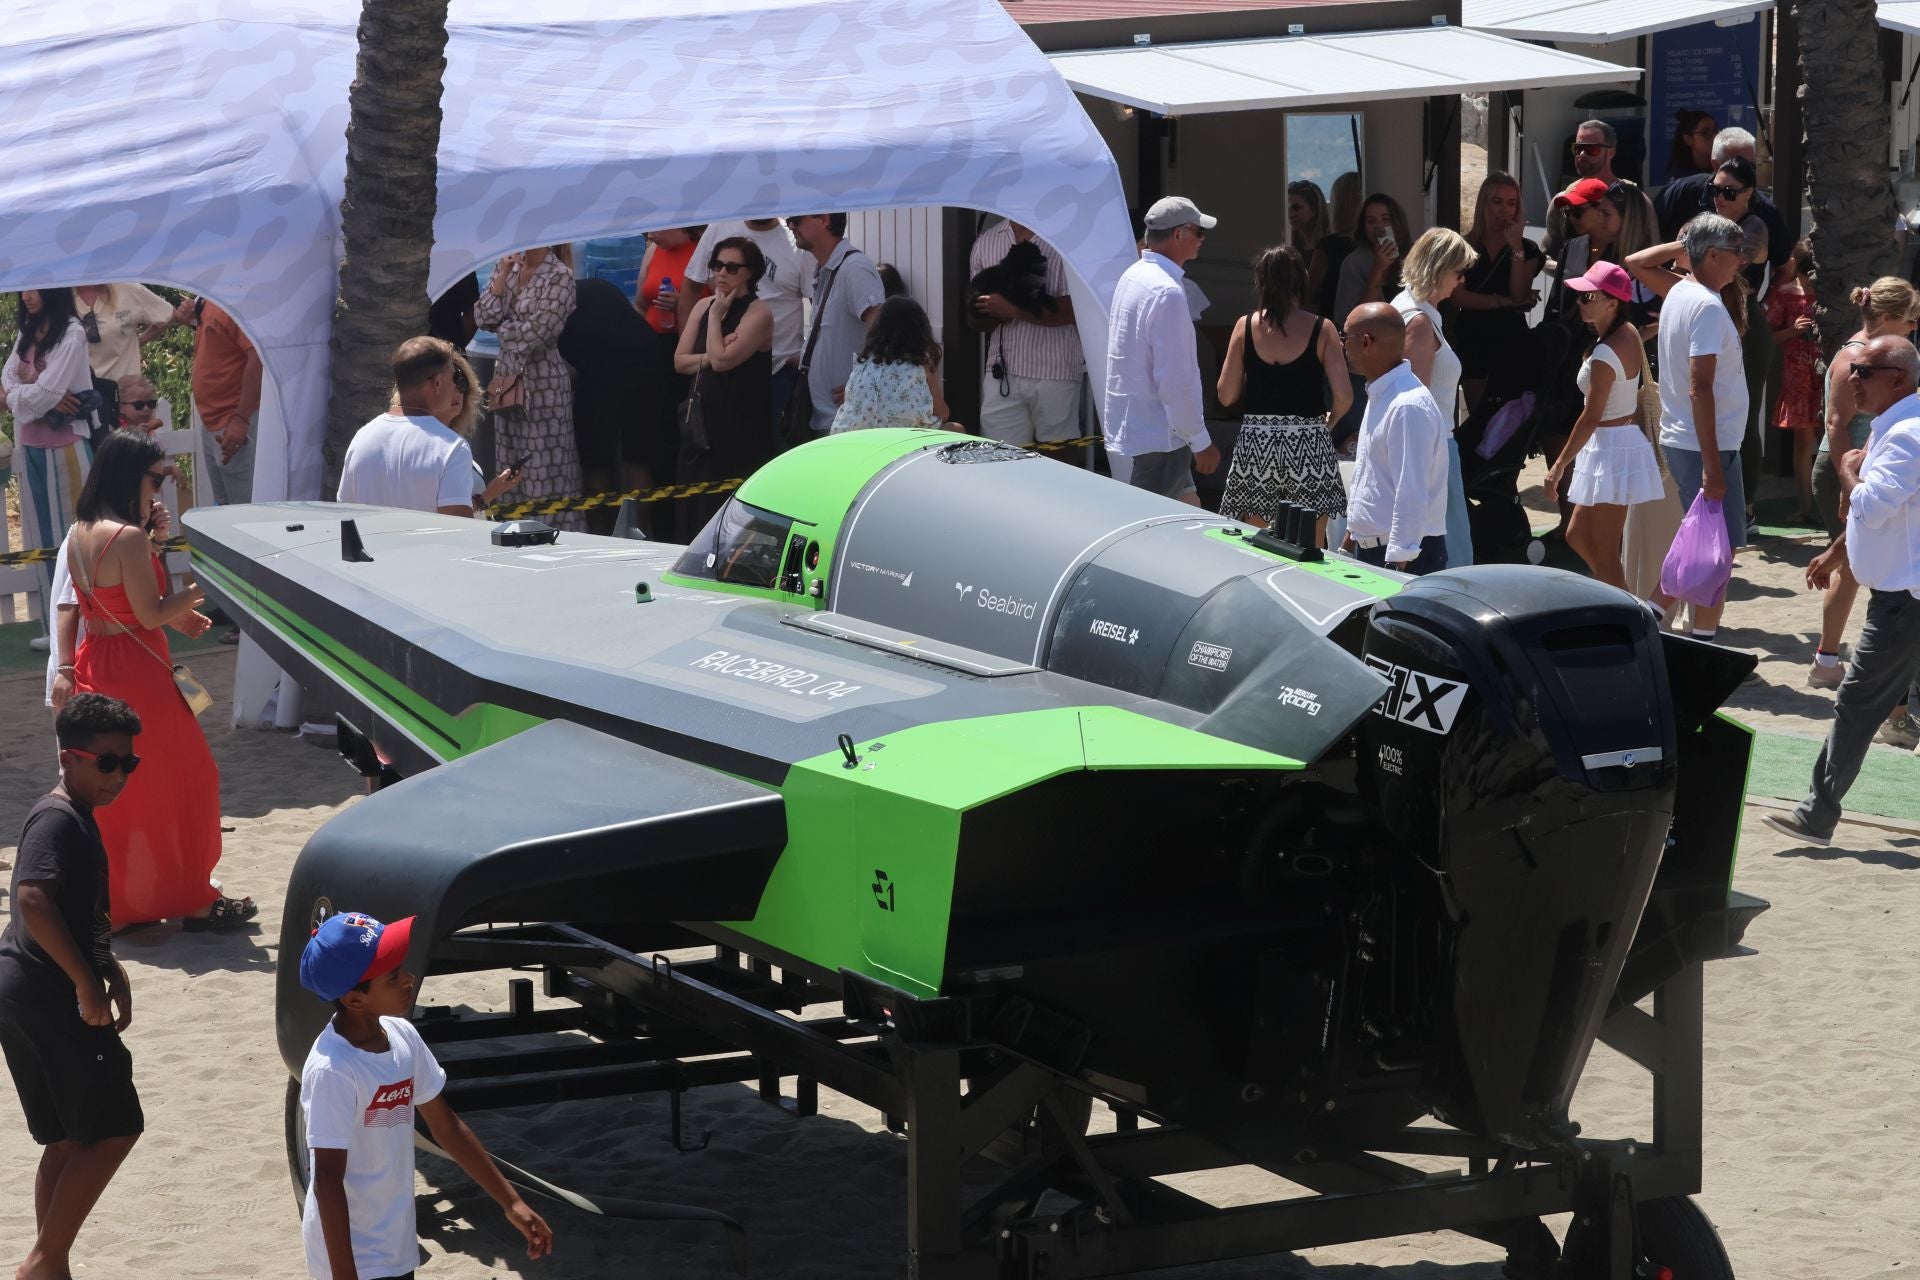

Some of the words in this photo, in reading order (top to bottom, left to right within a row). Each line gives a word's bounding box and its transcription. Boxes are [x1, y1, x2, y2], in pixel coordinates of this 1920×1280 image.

[850, 560, 880, 574] VICTORY
[879, 569, 906, 581] MARINE
[977, 588, 1037, 621] Seabird
[1089, 618, 1128, 643] KREISEL
[1190, 653, 1199, 662] OF
[1198, 654, 1209, 665] THE
[1193, 643, 1231, 660] CHAMPIONS
[689, 650, 862, 701] RACEBIRD_04
[1277, 685, 1322, 717] Racing
[1293, 687, 1319, 701] MERCURY
[1383, 744, 1403, 766] 100%
